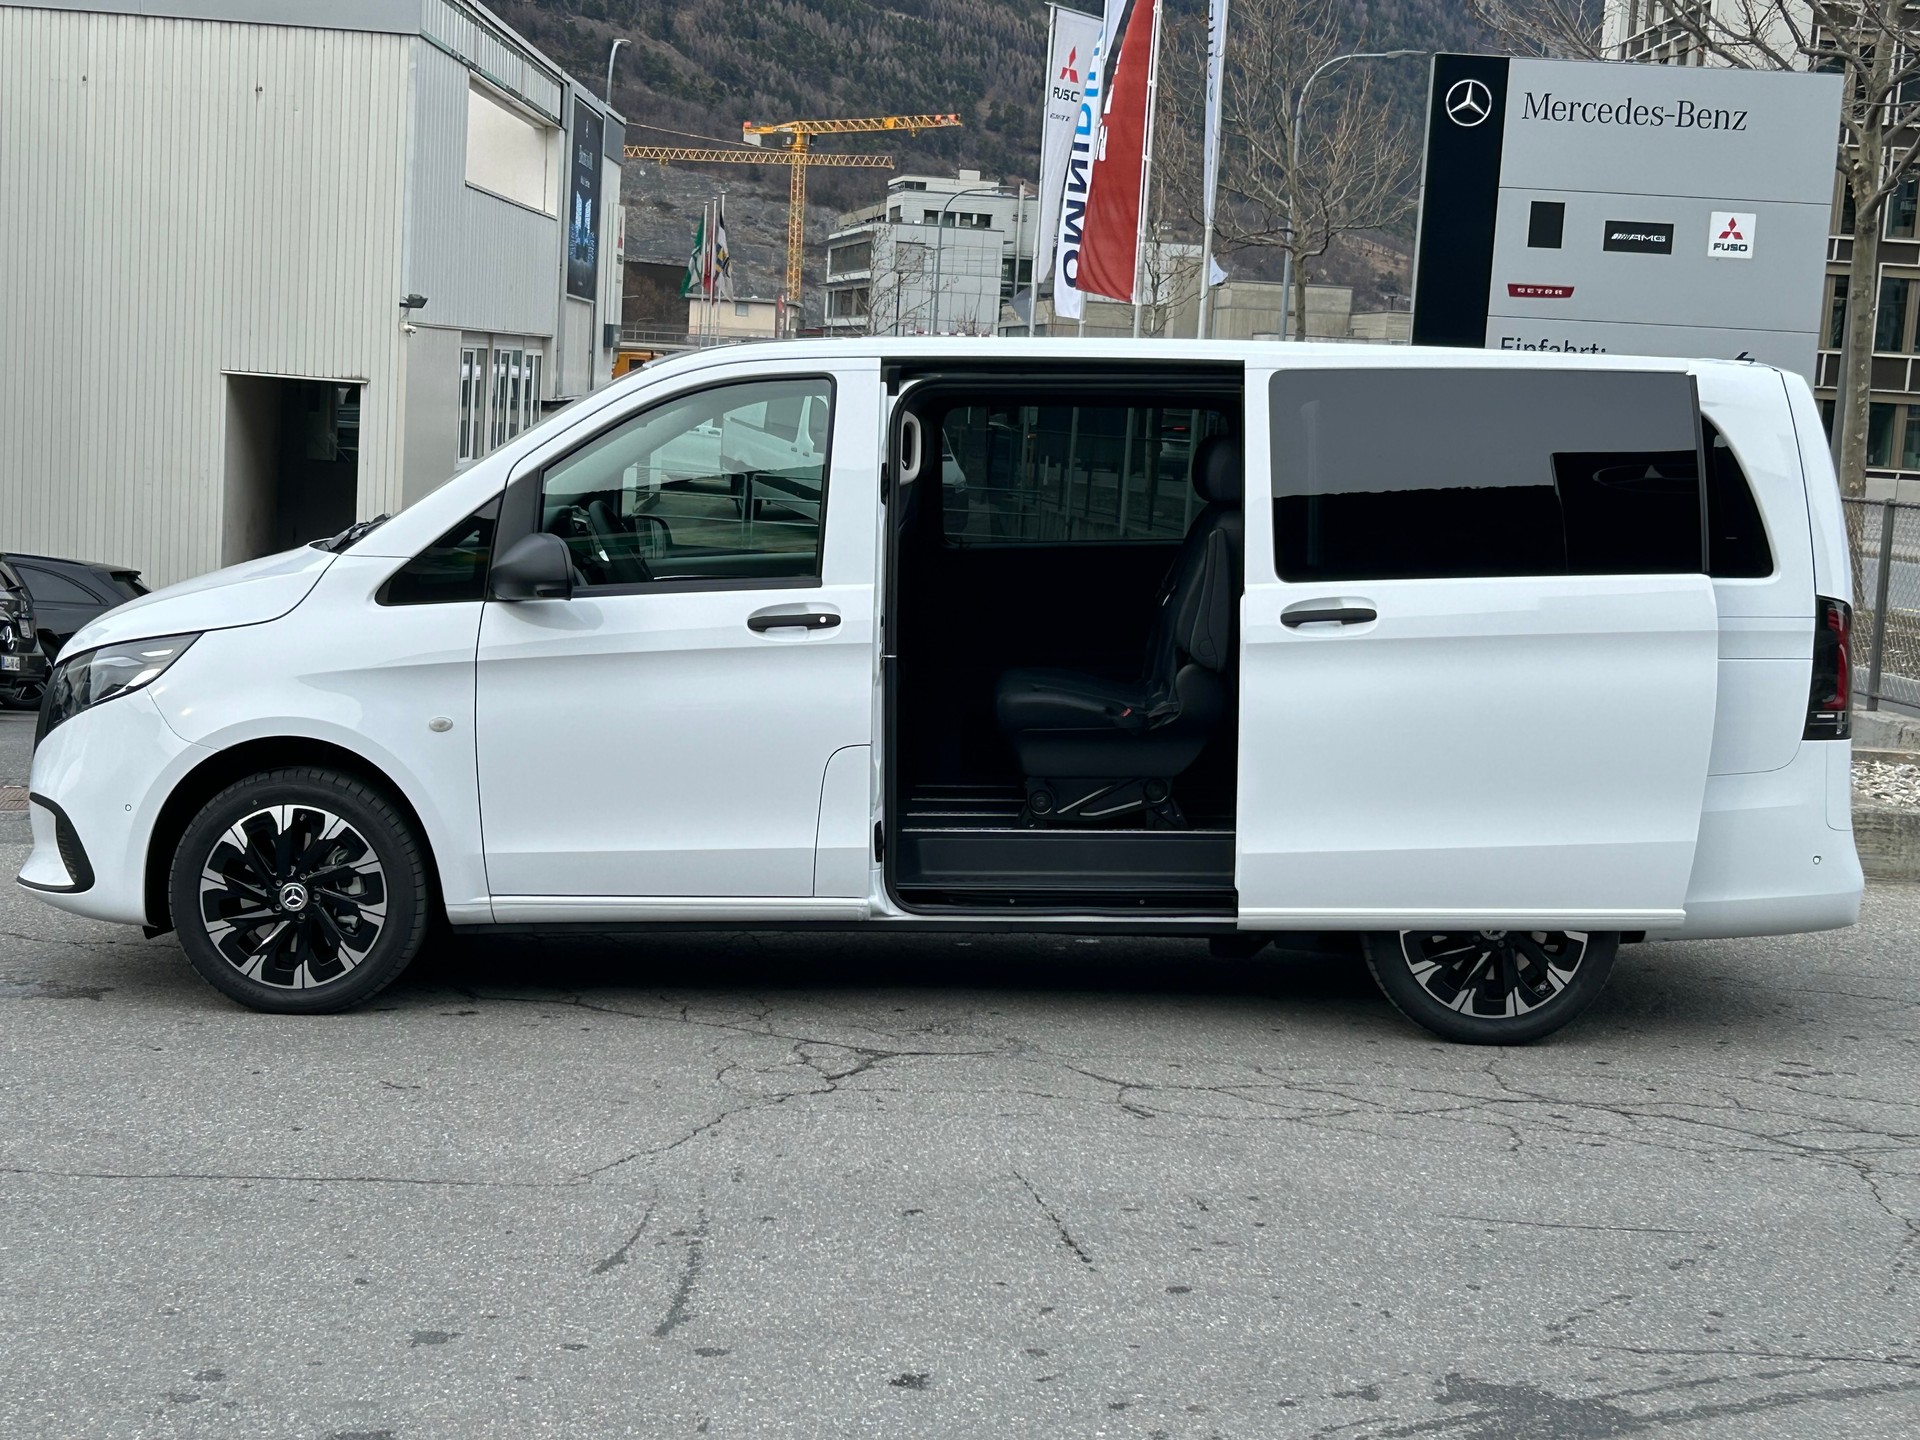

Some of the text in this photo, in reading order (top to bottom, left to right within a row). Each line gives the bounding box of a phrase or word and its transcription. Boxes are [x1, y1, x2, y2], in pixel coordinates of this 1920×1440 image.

[1521, 91, 1749, 131] Mercedes-Benz
[1628, 233, 1666, 243] AMG
[1713, 242, 1748, 252] FUSO
